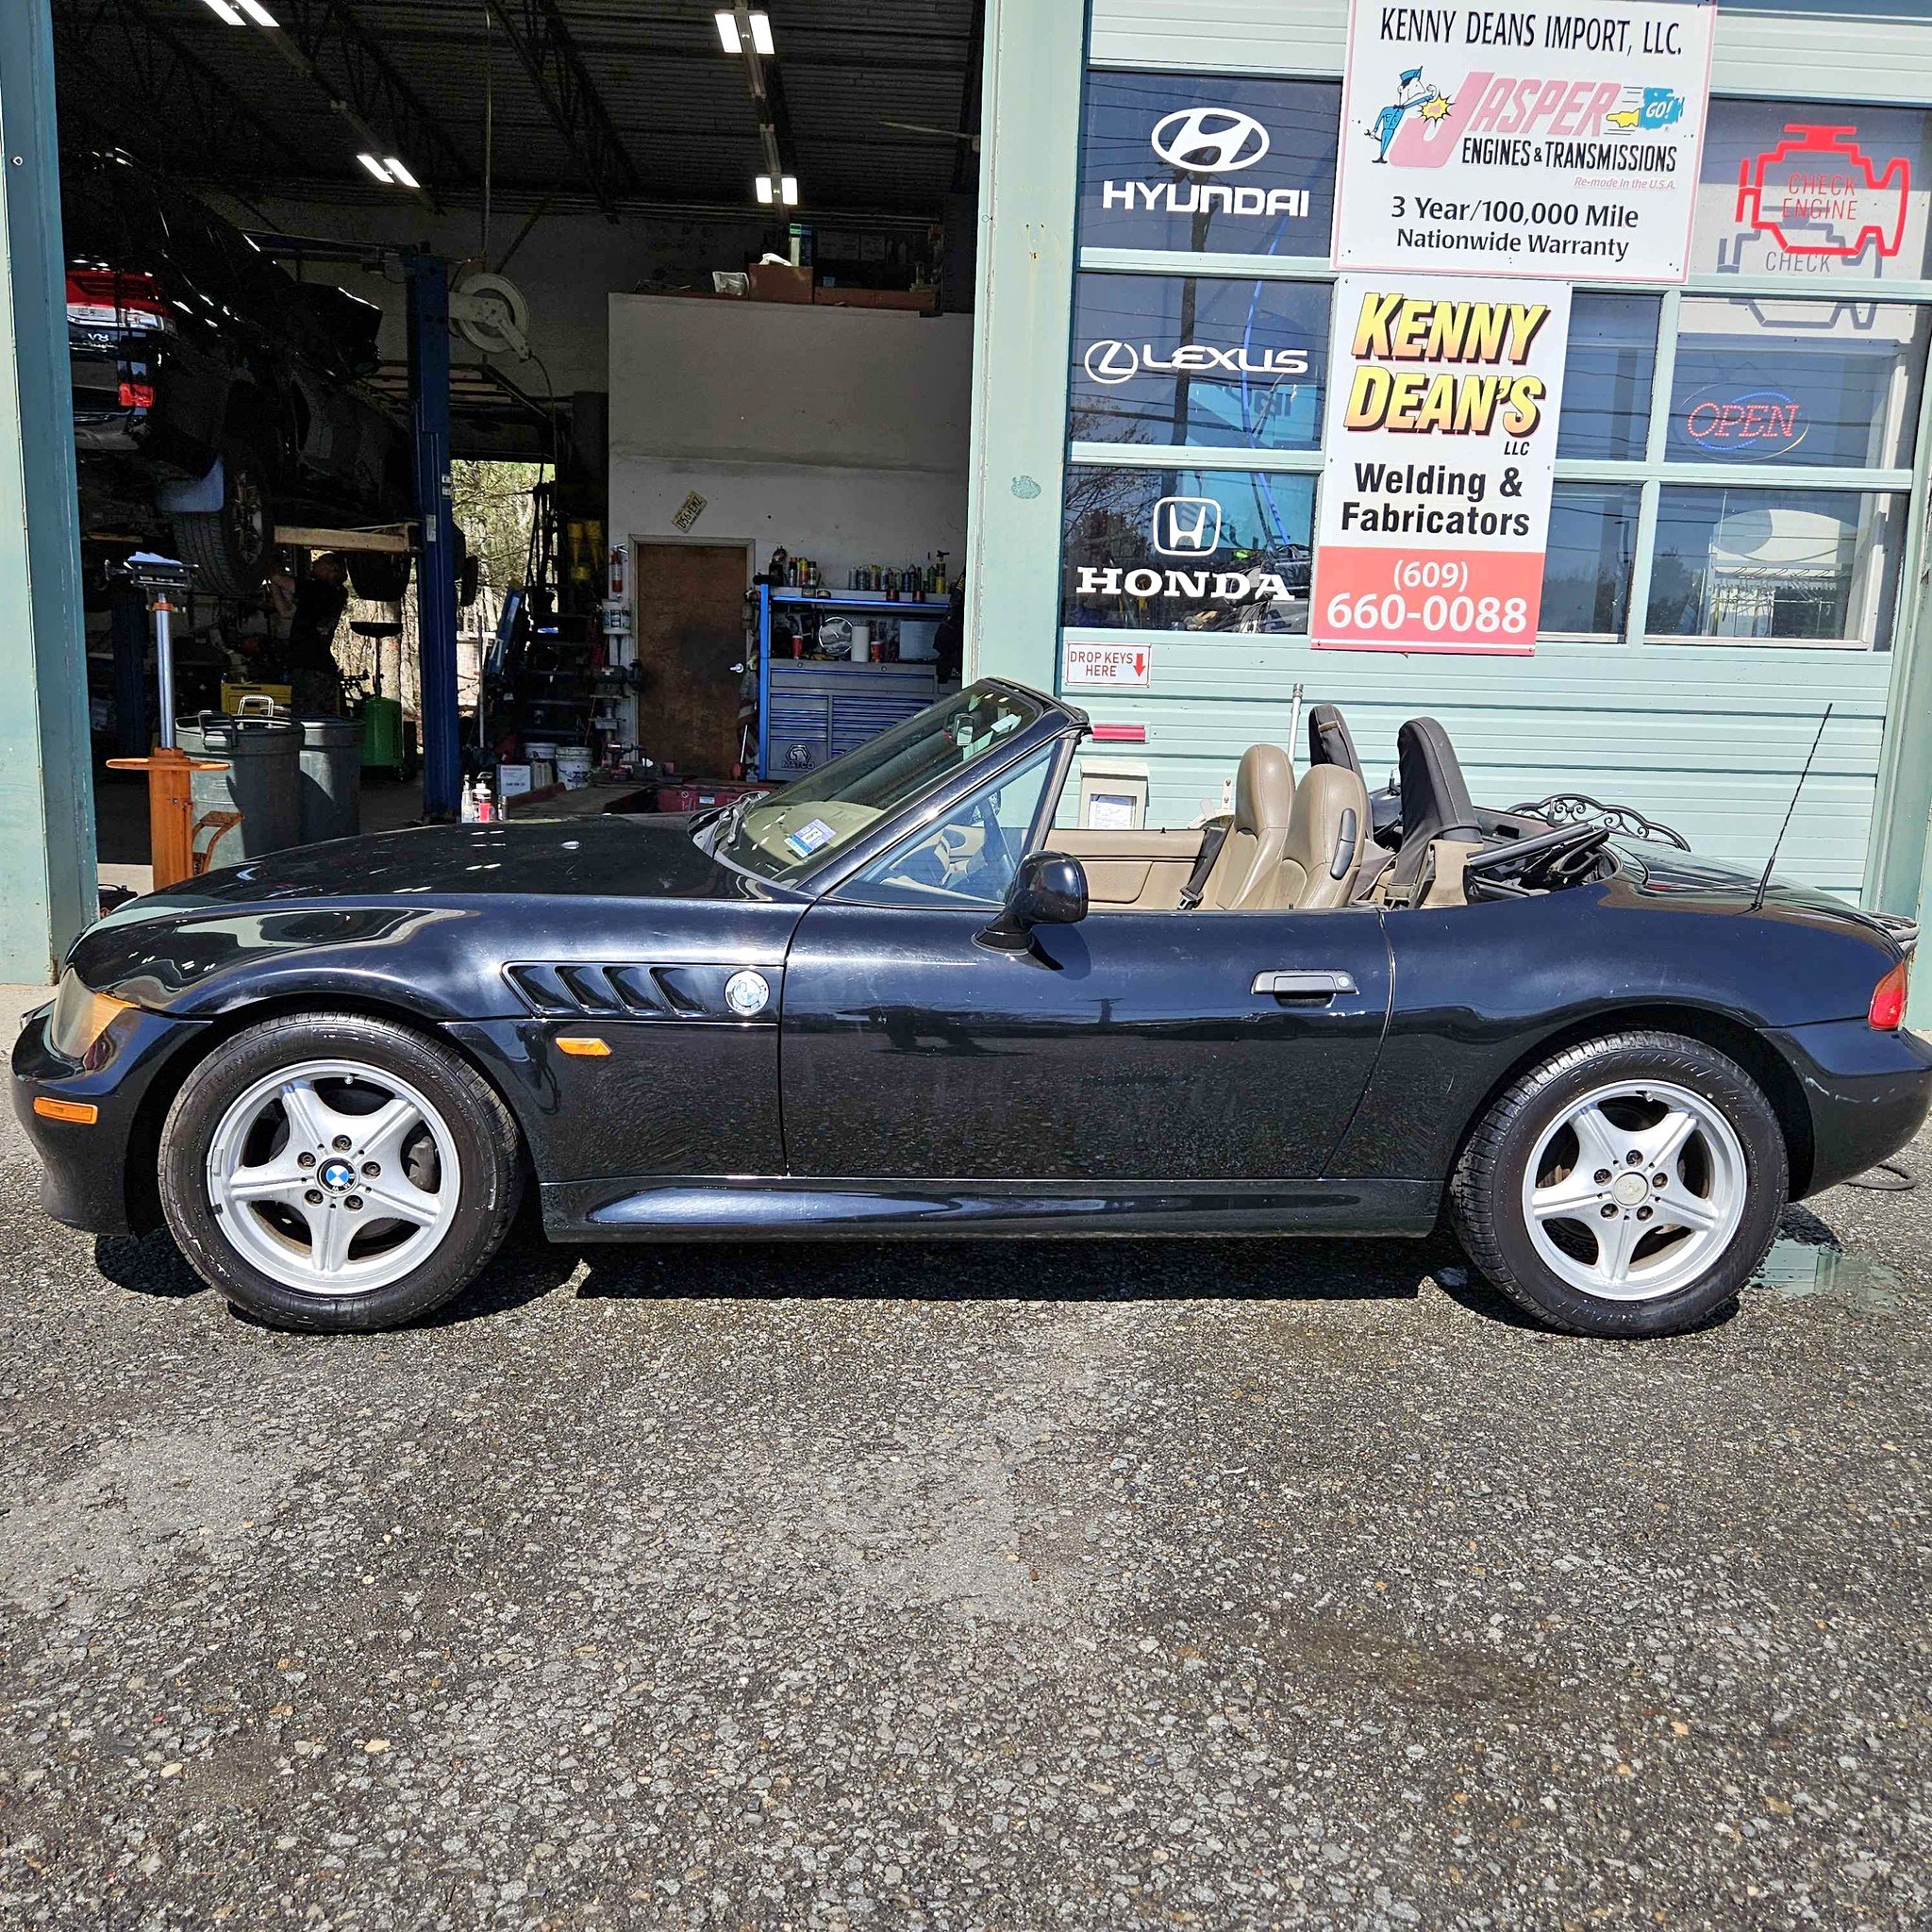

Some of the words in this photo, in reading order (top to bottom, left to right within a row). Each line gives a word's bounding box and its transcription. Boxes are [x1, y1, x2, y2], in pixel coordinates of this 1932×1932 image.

[1380, 8, 1457, 43] KENNY
[1465, 11, 1536, 47] DEANS
[1544, 15, 1632, 56] IMPORT,
[1642, 21, 1682, 55] LLC.
[1389, 71, 1622, 168] JASPER
[1645, 102, 1673, 119] GO!
[1462, 138, 1531, 167] ENGINES
[1533, 147, 1542, 162] &
[1545, 142, 1677, 173] TRANSMISSIONS
[1103, 180, 1309, 217] HYUNDAI
[1574, 176, 1619, 188] Re-made
[1631, 178, 1648, 189] the
[1649, 180, 1675, 190] U.S.A.
[1789, 173, 1856, 196] CHECK
[1391, 195, 1406, 218] 3
[1414, 196, 1578, 226] Year/100,000
[1585, 204, 1639, 228] Mile
[1782, 198, 1858, 220] ENGINE
[1396, 228, 1522, 252] Nationwide
[1528, 234, 1629, 263] Warranty
[1766, 251, 1830, 272] CHECK
[1351, 292, 1552, 365] KENNY
[1142, 344, 1308, 374] LEXUS
[1343, 365, 1546, 438] DEAN'S
[1687, 402, 1800, 438] OPEN
[1504, 441, 1530, 456] LLC
[1355, 463, 1486, 502] Welding
[1499, 467, 1523, 497] &
[1341, 502, 1530, 536] Fabricators
[1076, 566, 1295, 601] HONDA
[1393, 559, 1468, 592] (609)
[1326, 592, 1526, 634] 660-0088
[1070, 651, 1102, 664] DROP
[1105, 652, 1133, 664] KEYS
[1085, 665, 1117, 677] HERE
